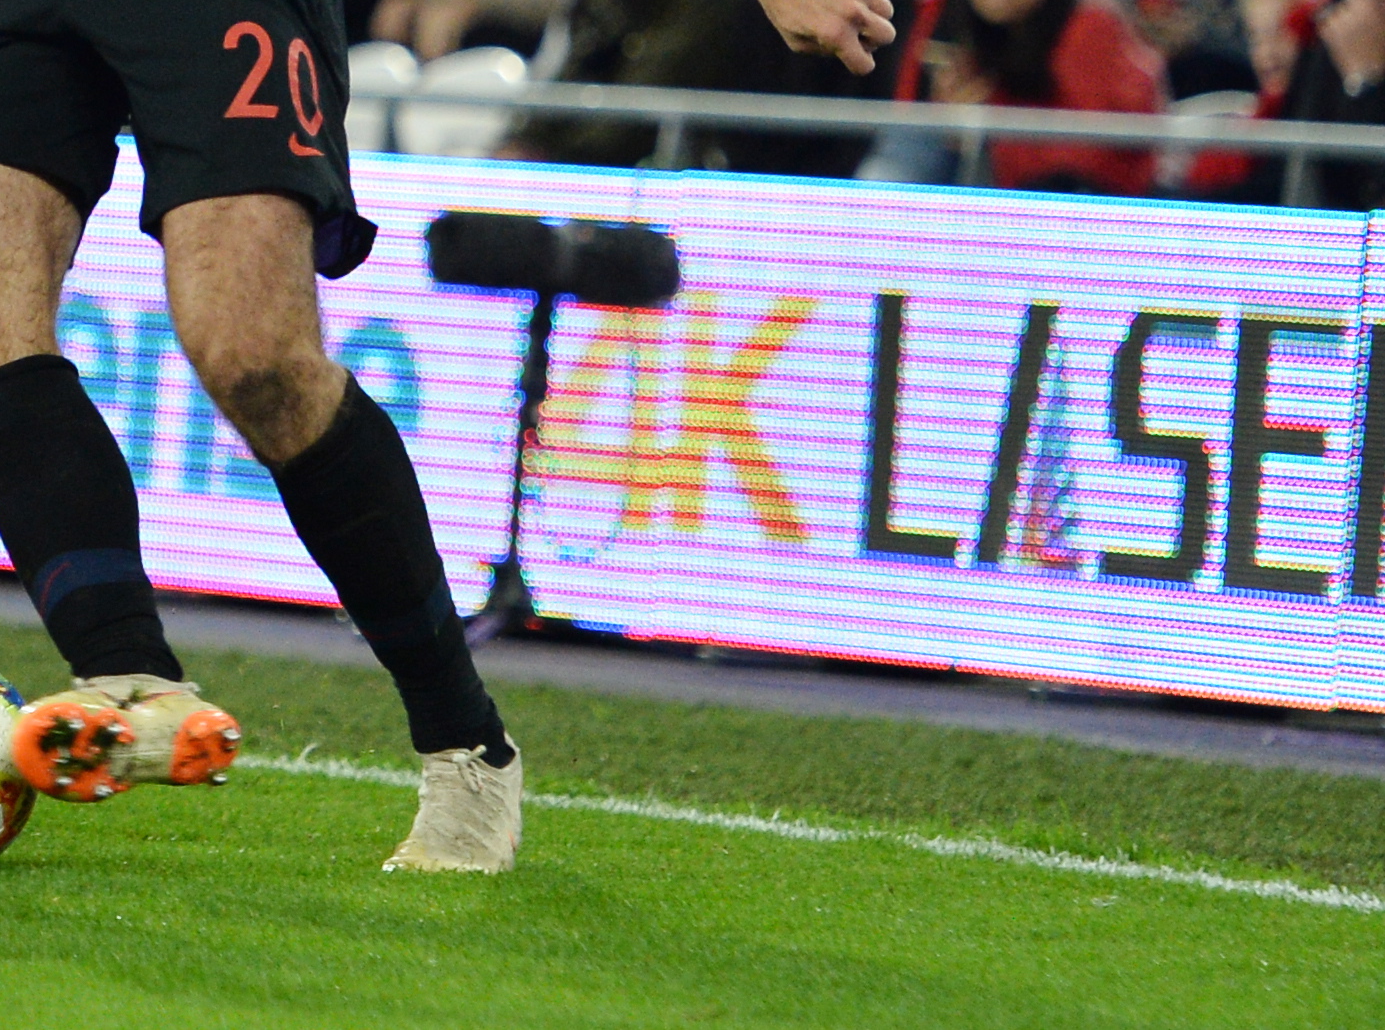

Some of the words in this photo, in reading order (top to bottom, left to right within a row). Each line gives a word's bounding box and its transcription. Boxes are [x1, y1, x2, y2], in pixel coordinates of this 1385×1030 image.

[222, 20, 324, 137] 20
[522, 290, 818, 542] 4K
[860, 291, 1385, 601] LASE
